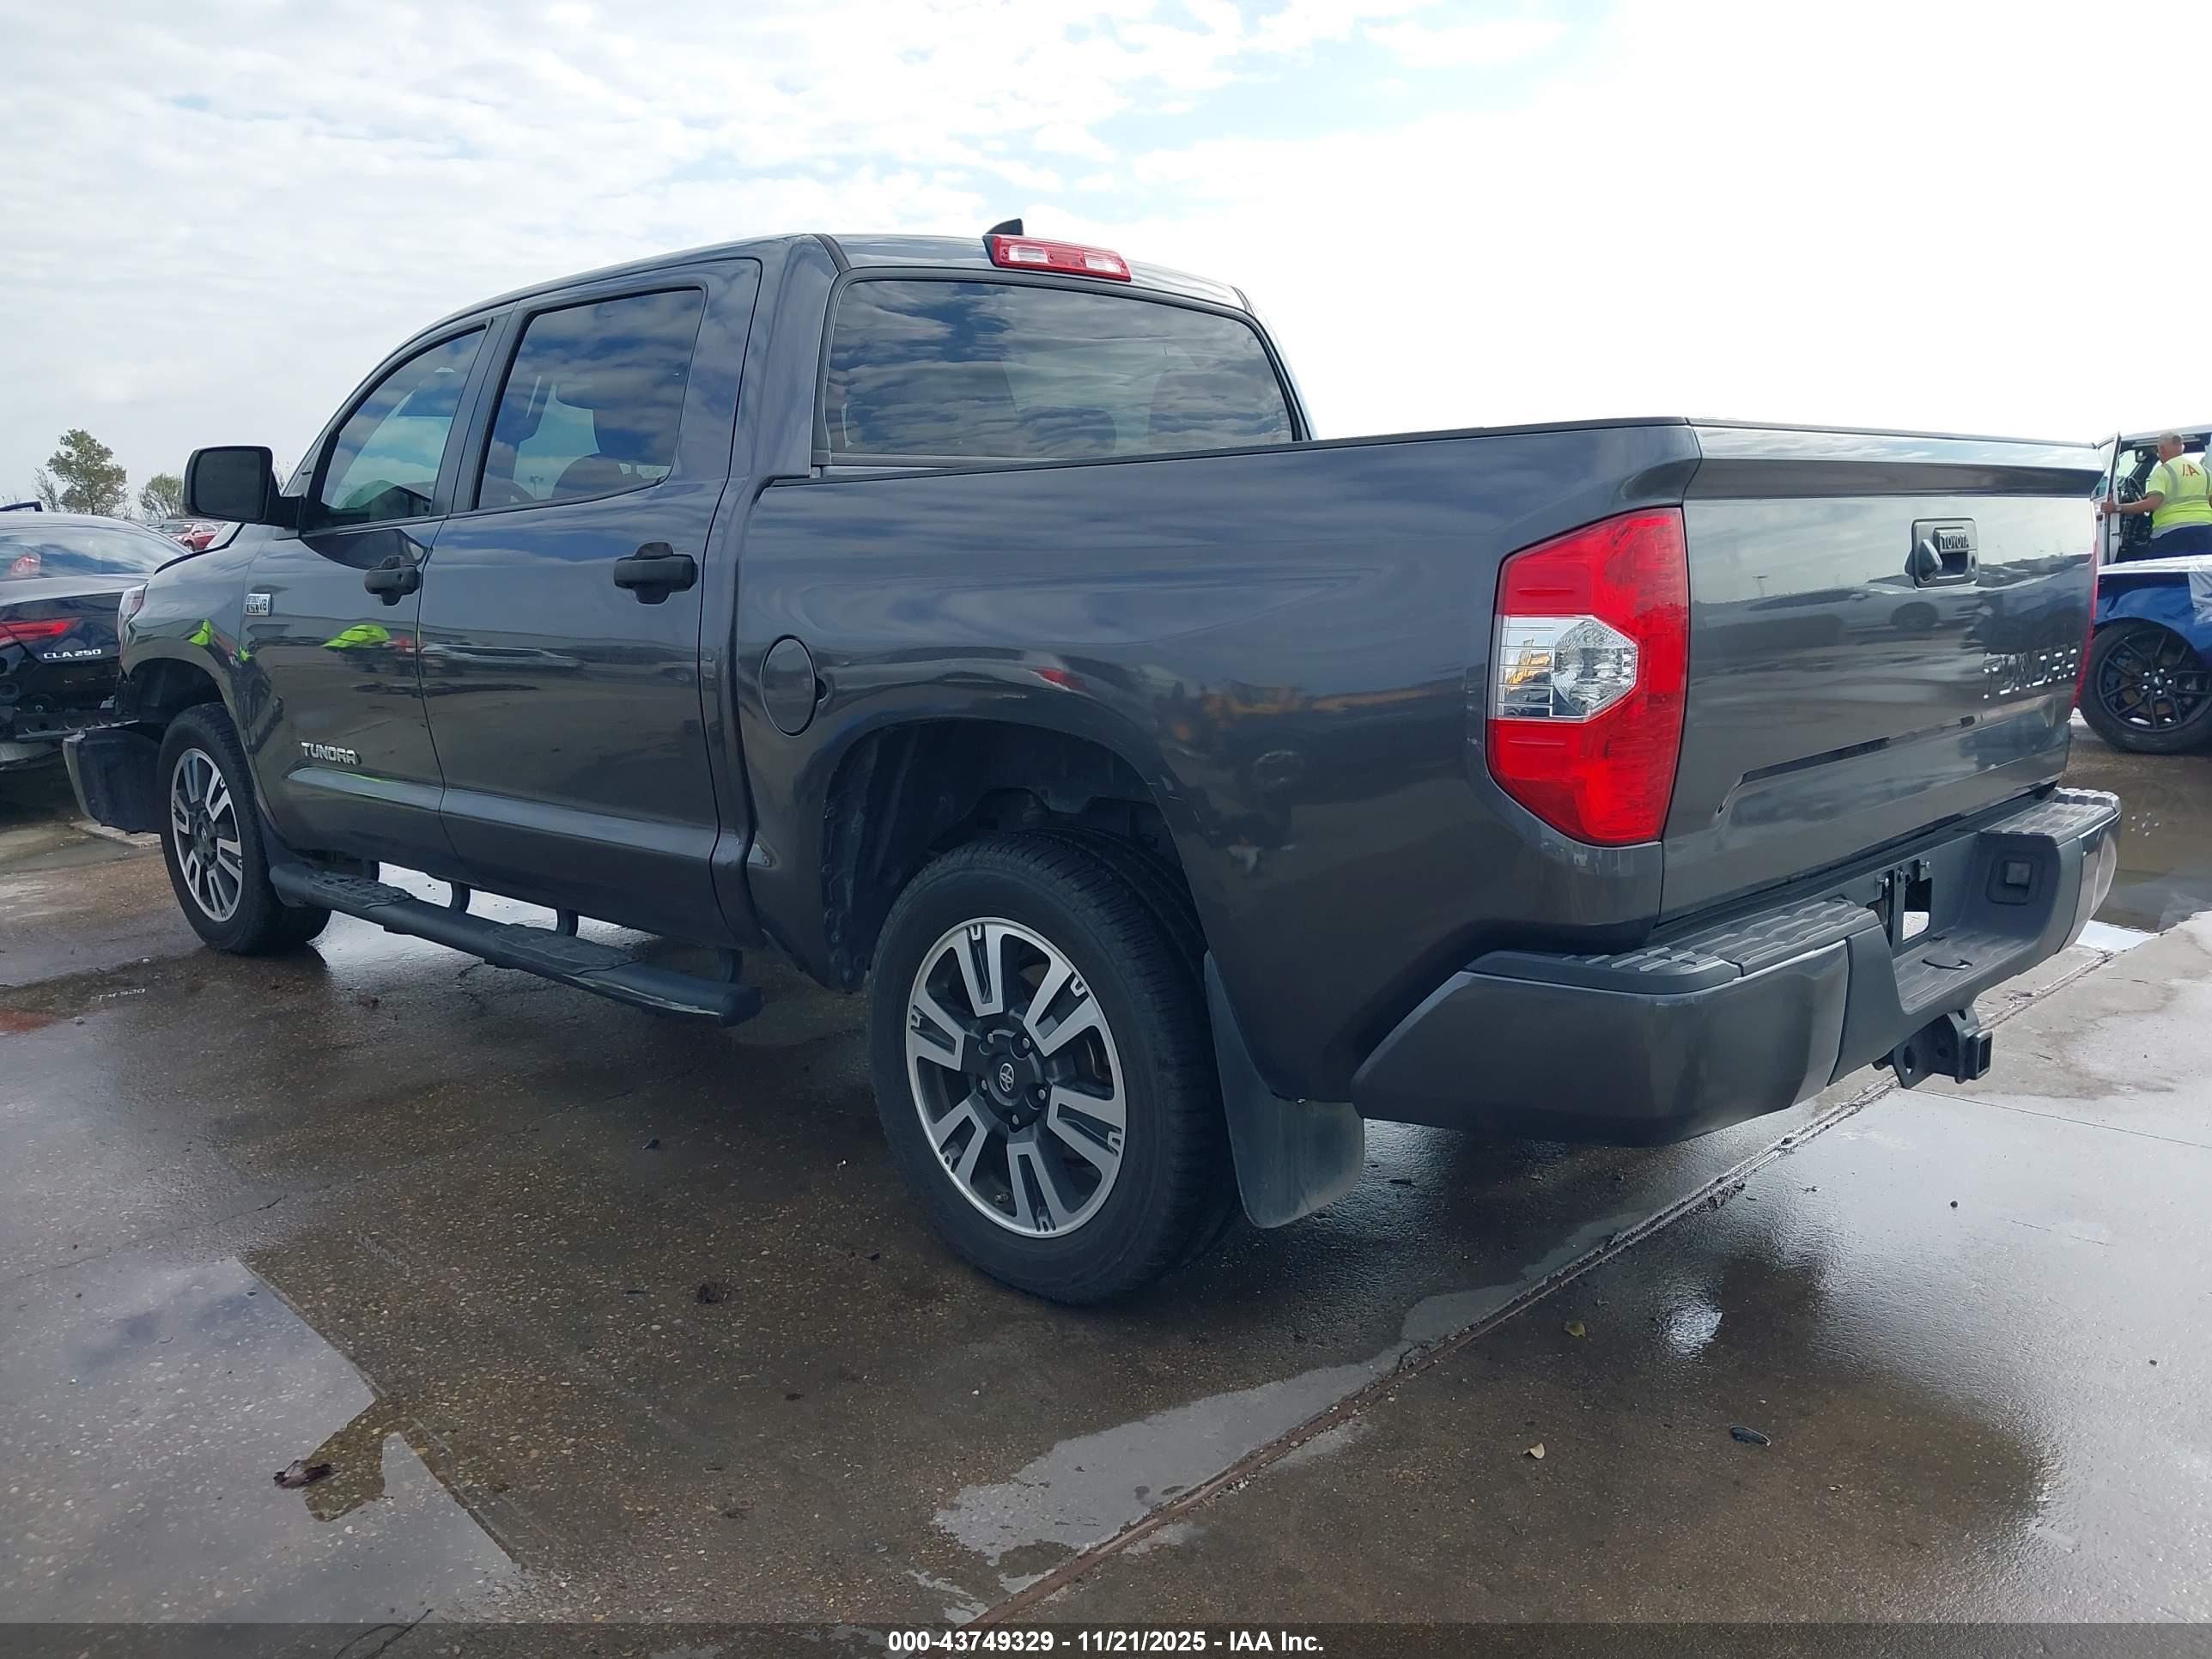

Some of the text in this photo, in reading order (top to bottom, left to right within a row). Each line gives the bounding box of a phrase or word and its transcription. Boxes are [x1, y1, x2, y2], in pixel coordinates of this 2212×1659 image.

[1941, 534, 1970, 550] TOYOTA
[74, 648, 101, 657] 250
[301, 741, 356, 765] TUNDRA
